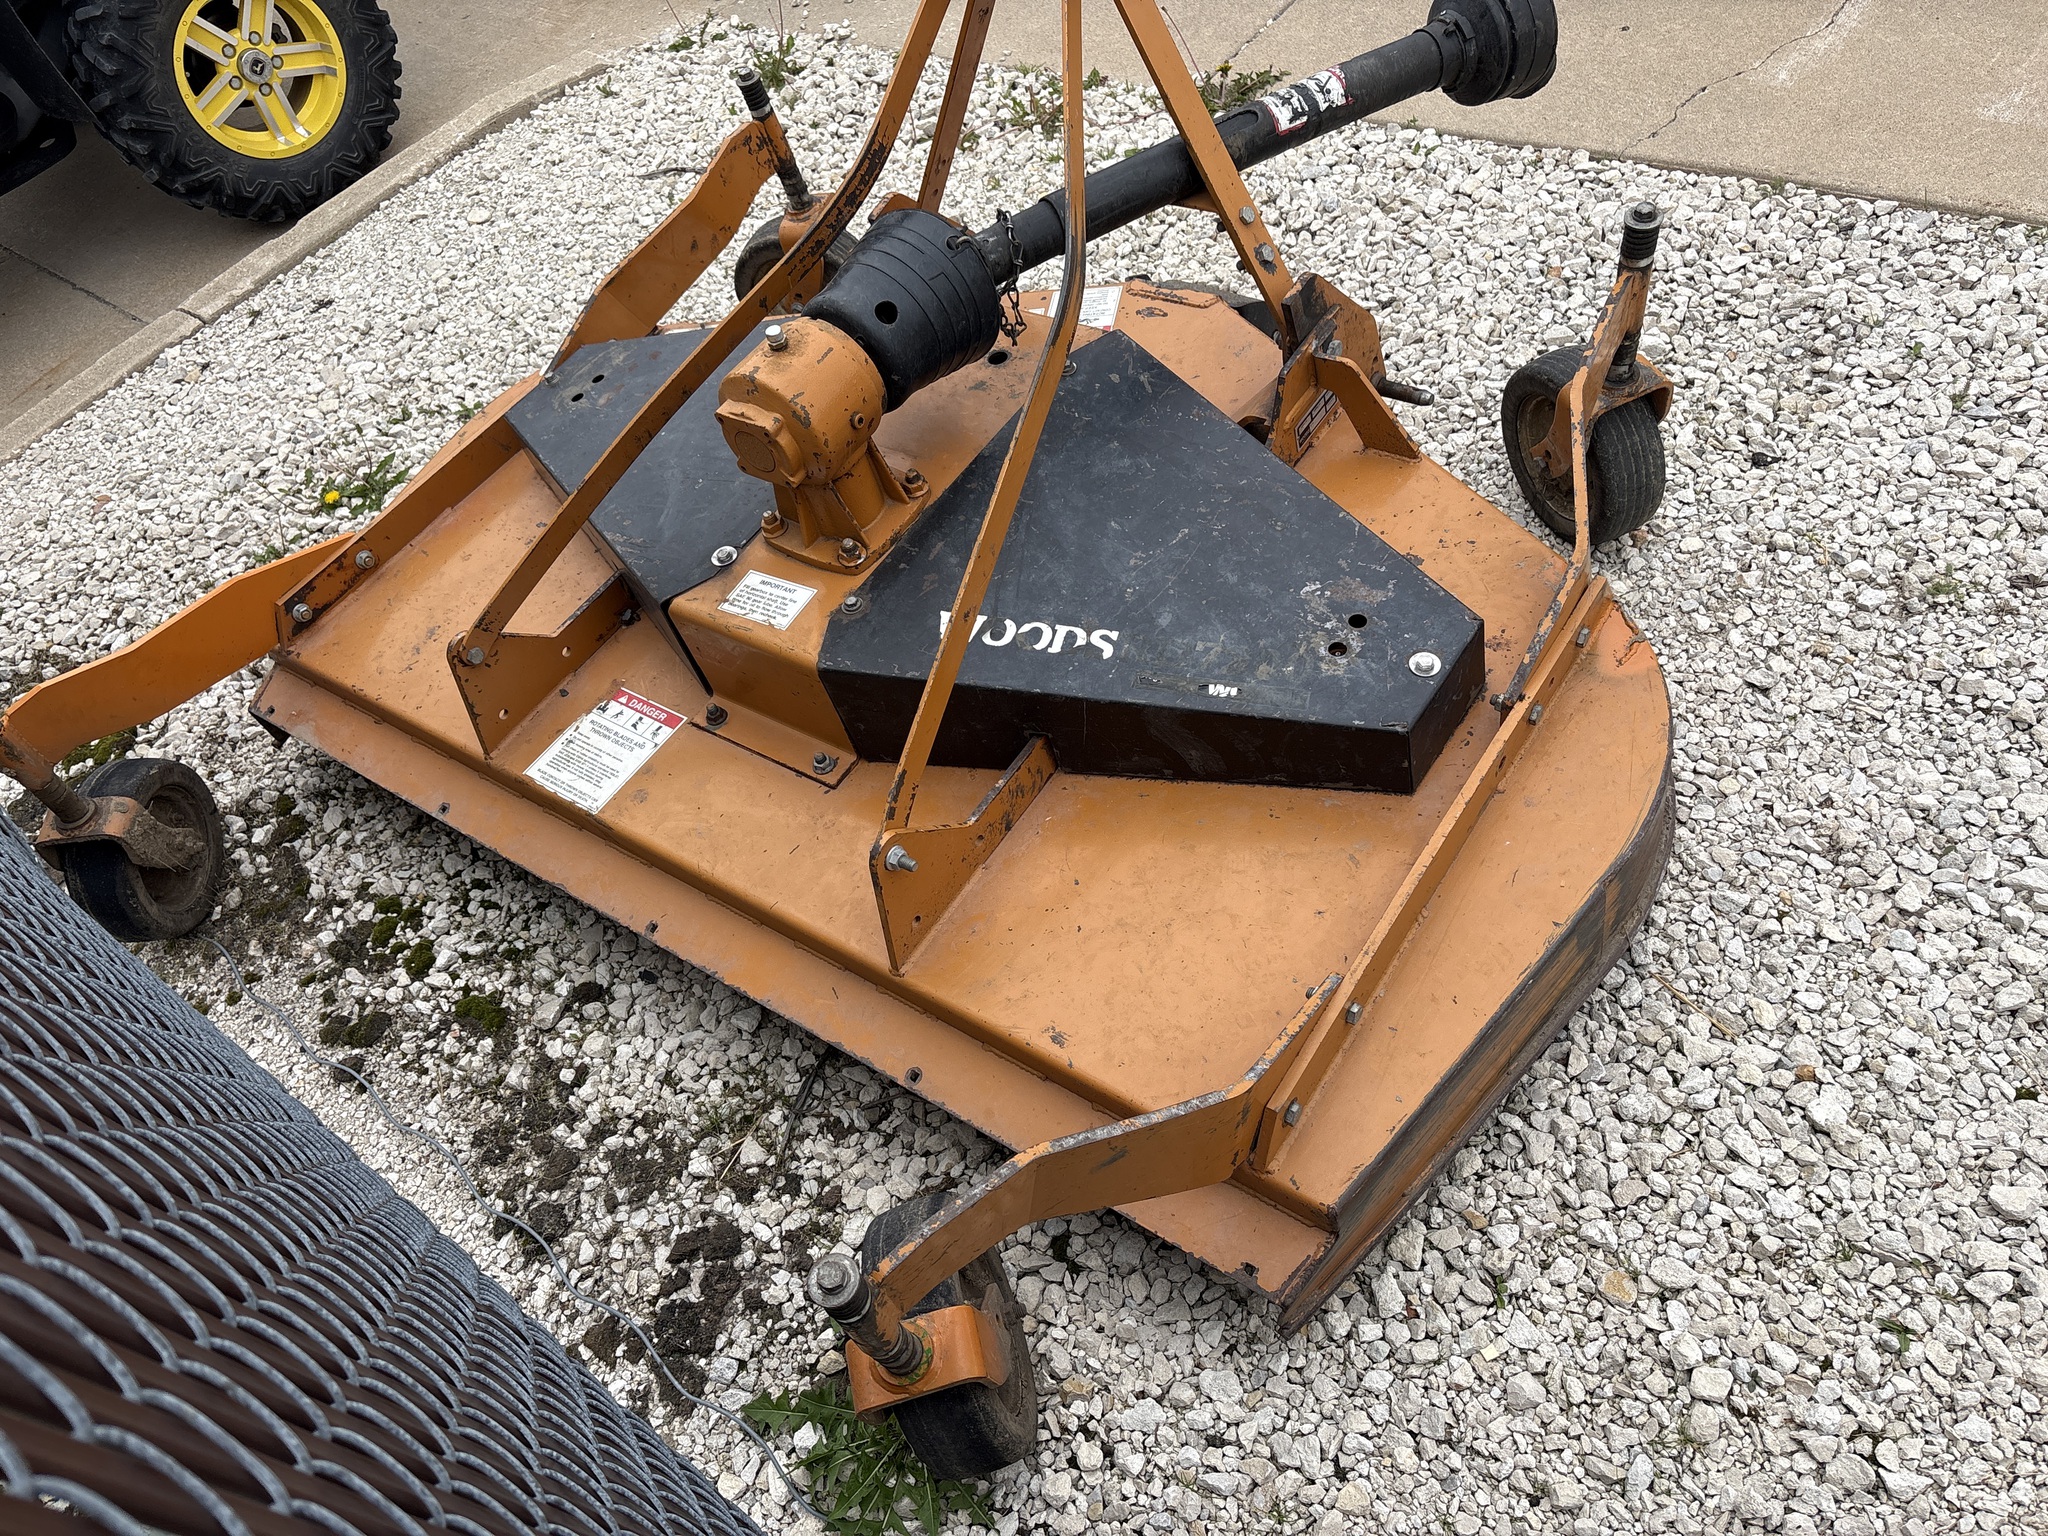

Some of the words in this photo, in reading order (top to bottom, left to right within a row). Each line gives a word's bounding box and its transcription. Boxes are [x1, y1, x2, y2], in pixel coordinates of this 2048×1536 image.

[759, 579, 797, 594] IMPORTANT
[628, 699, 668, 722] DANGER
[589, 719, 615, 734] ROTATING
[613, 731, 635, 744] BLADES
[633, 741, 646, 750] AND
[589, 727, 612, 741] THROWN
[611, 738, 635, 752] OBJECTS
